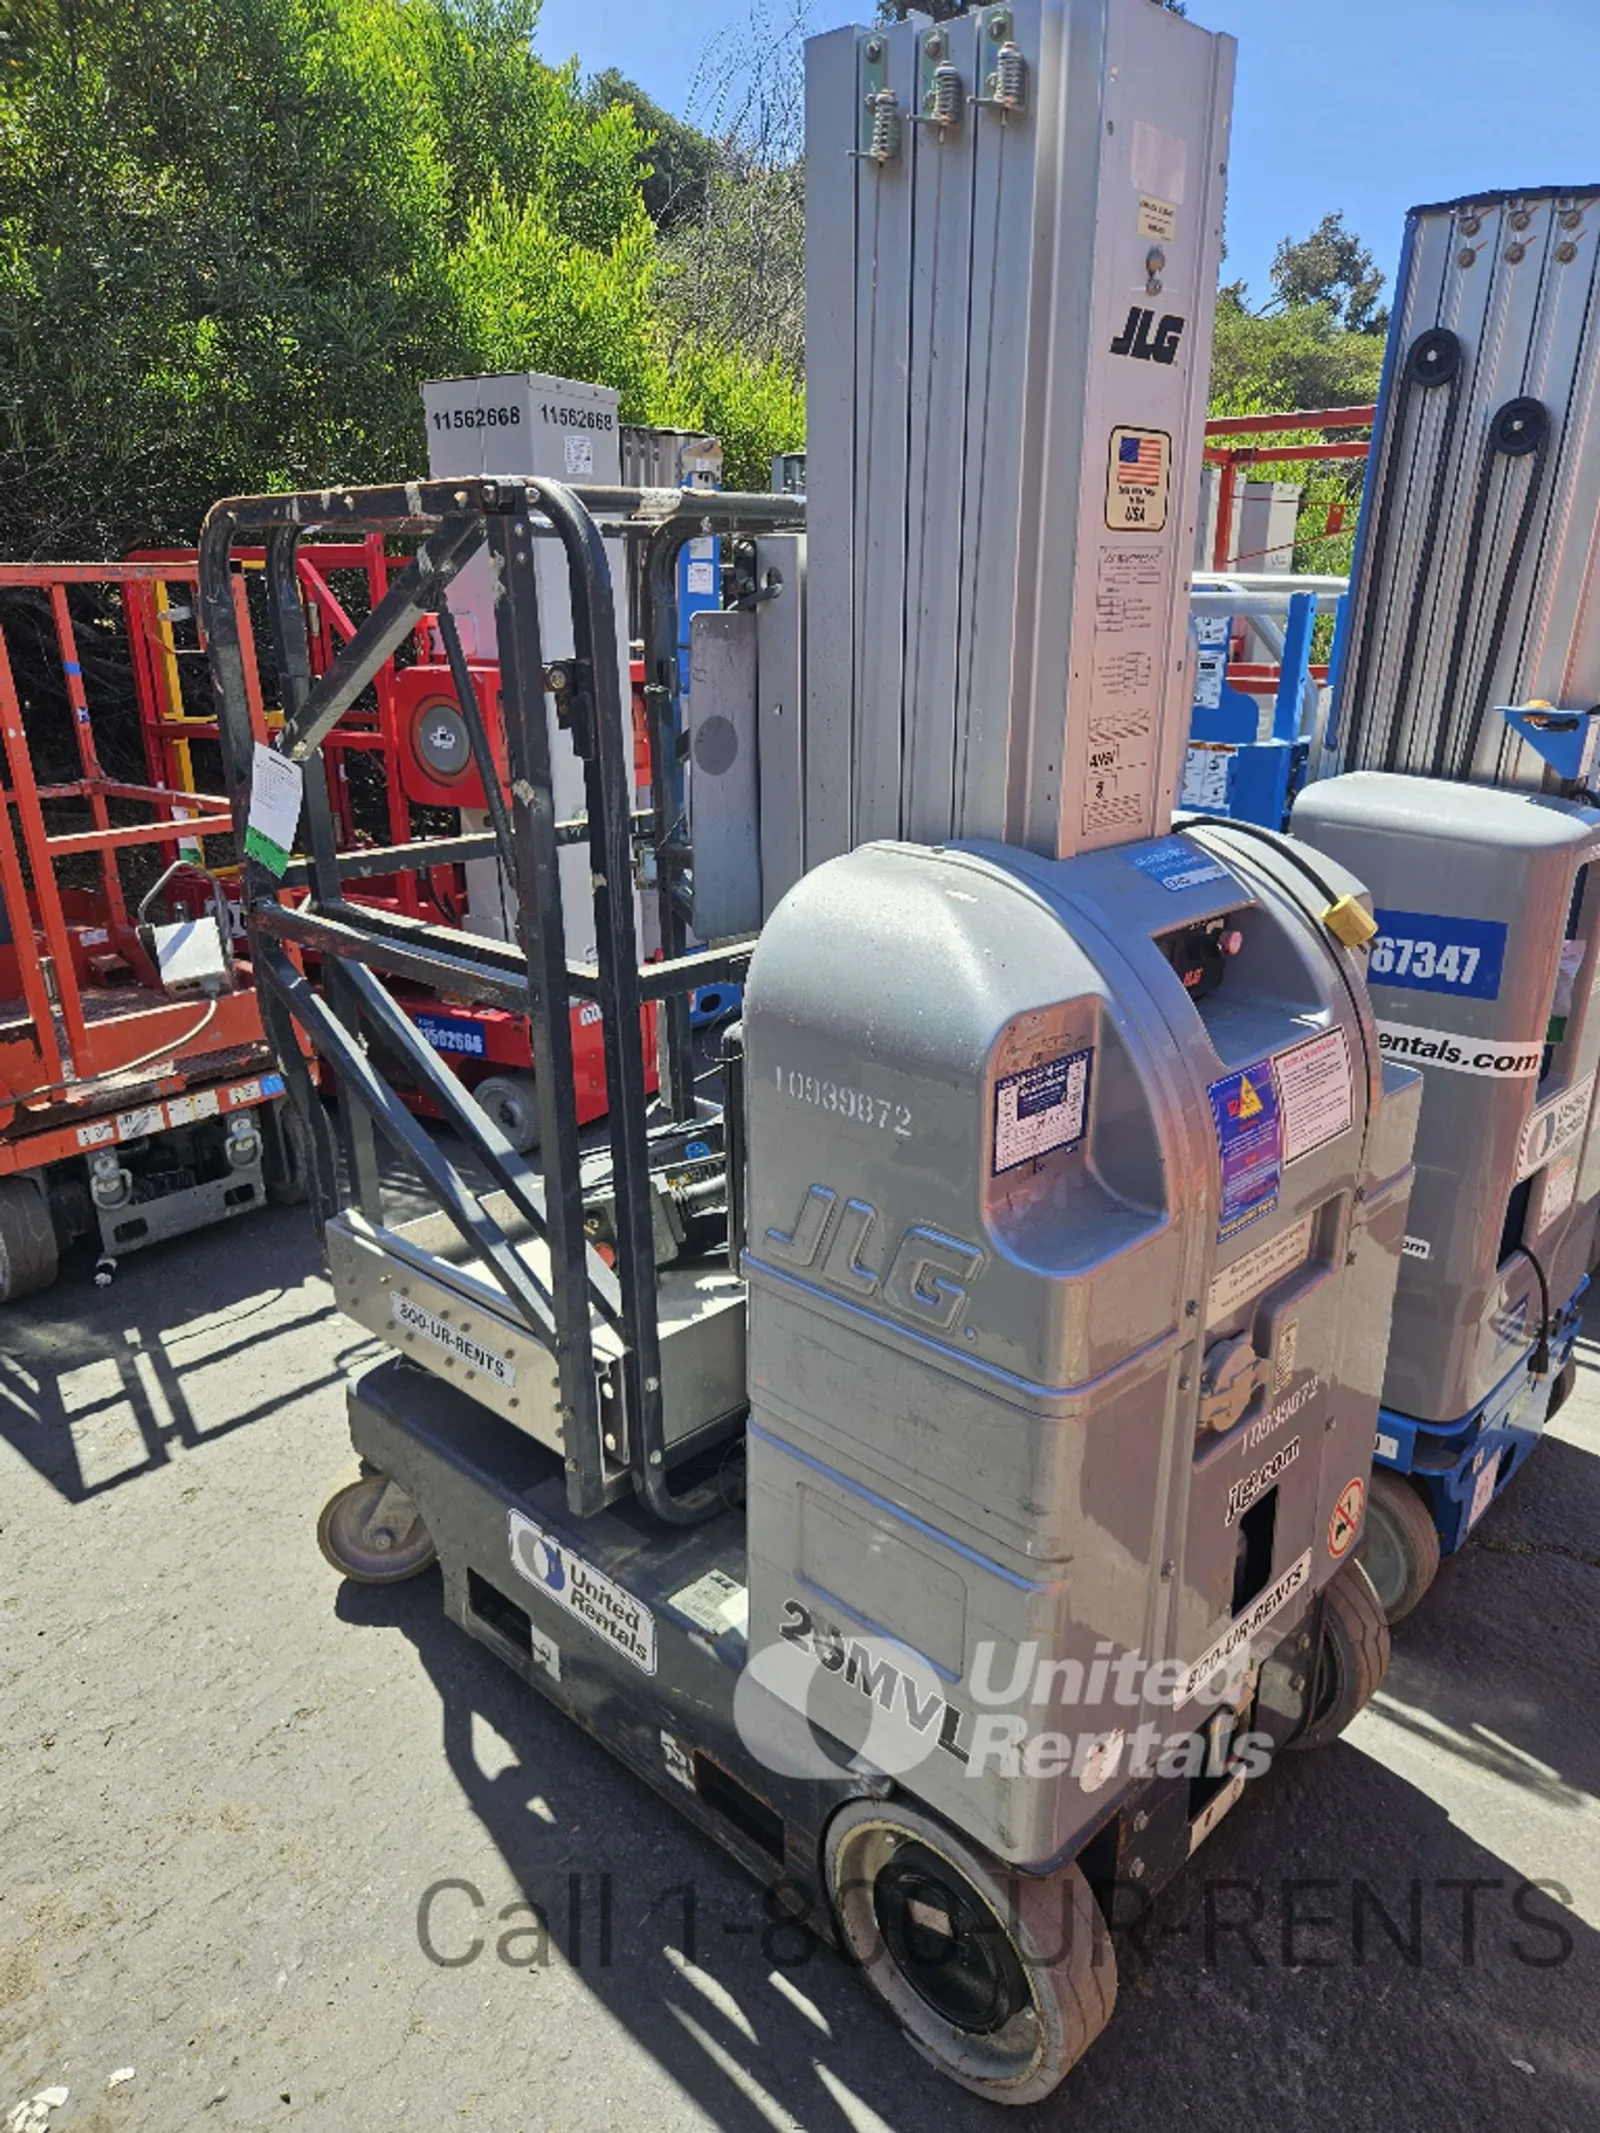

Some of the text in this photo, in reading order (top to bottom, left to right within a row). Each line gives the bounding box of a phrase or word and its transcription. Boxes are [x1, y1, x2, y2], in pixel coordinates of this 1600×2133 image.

[1109, 306, 1185, 365] JLG
[432, 405, 521, 431] 11562668
[541, 403, 614, 431] 11562668
[1125, 506, 1146, 522] USA
[1371, 936, 1481, 985] 67347
[763, 1183, 984, 1330] JLG
[570, 1563, 641, 1632] United
[571, 1588, 648, 1663] Rentals
